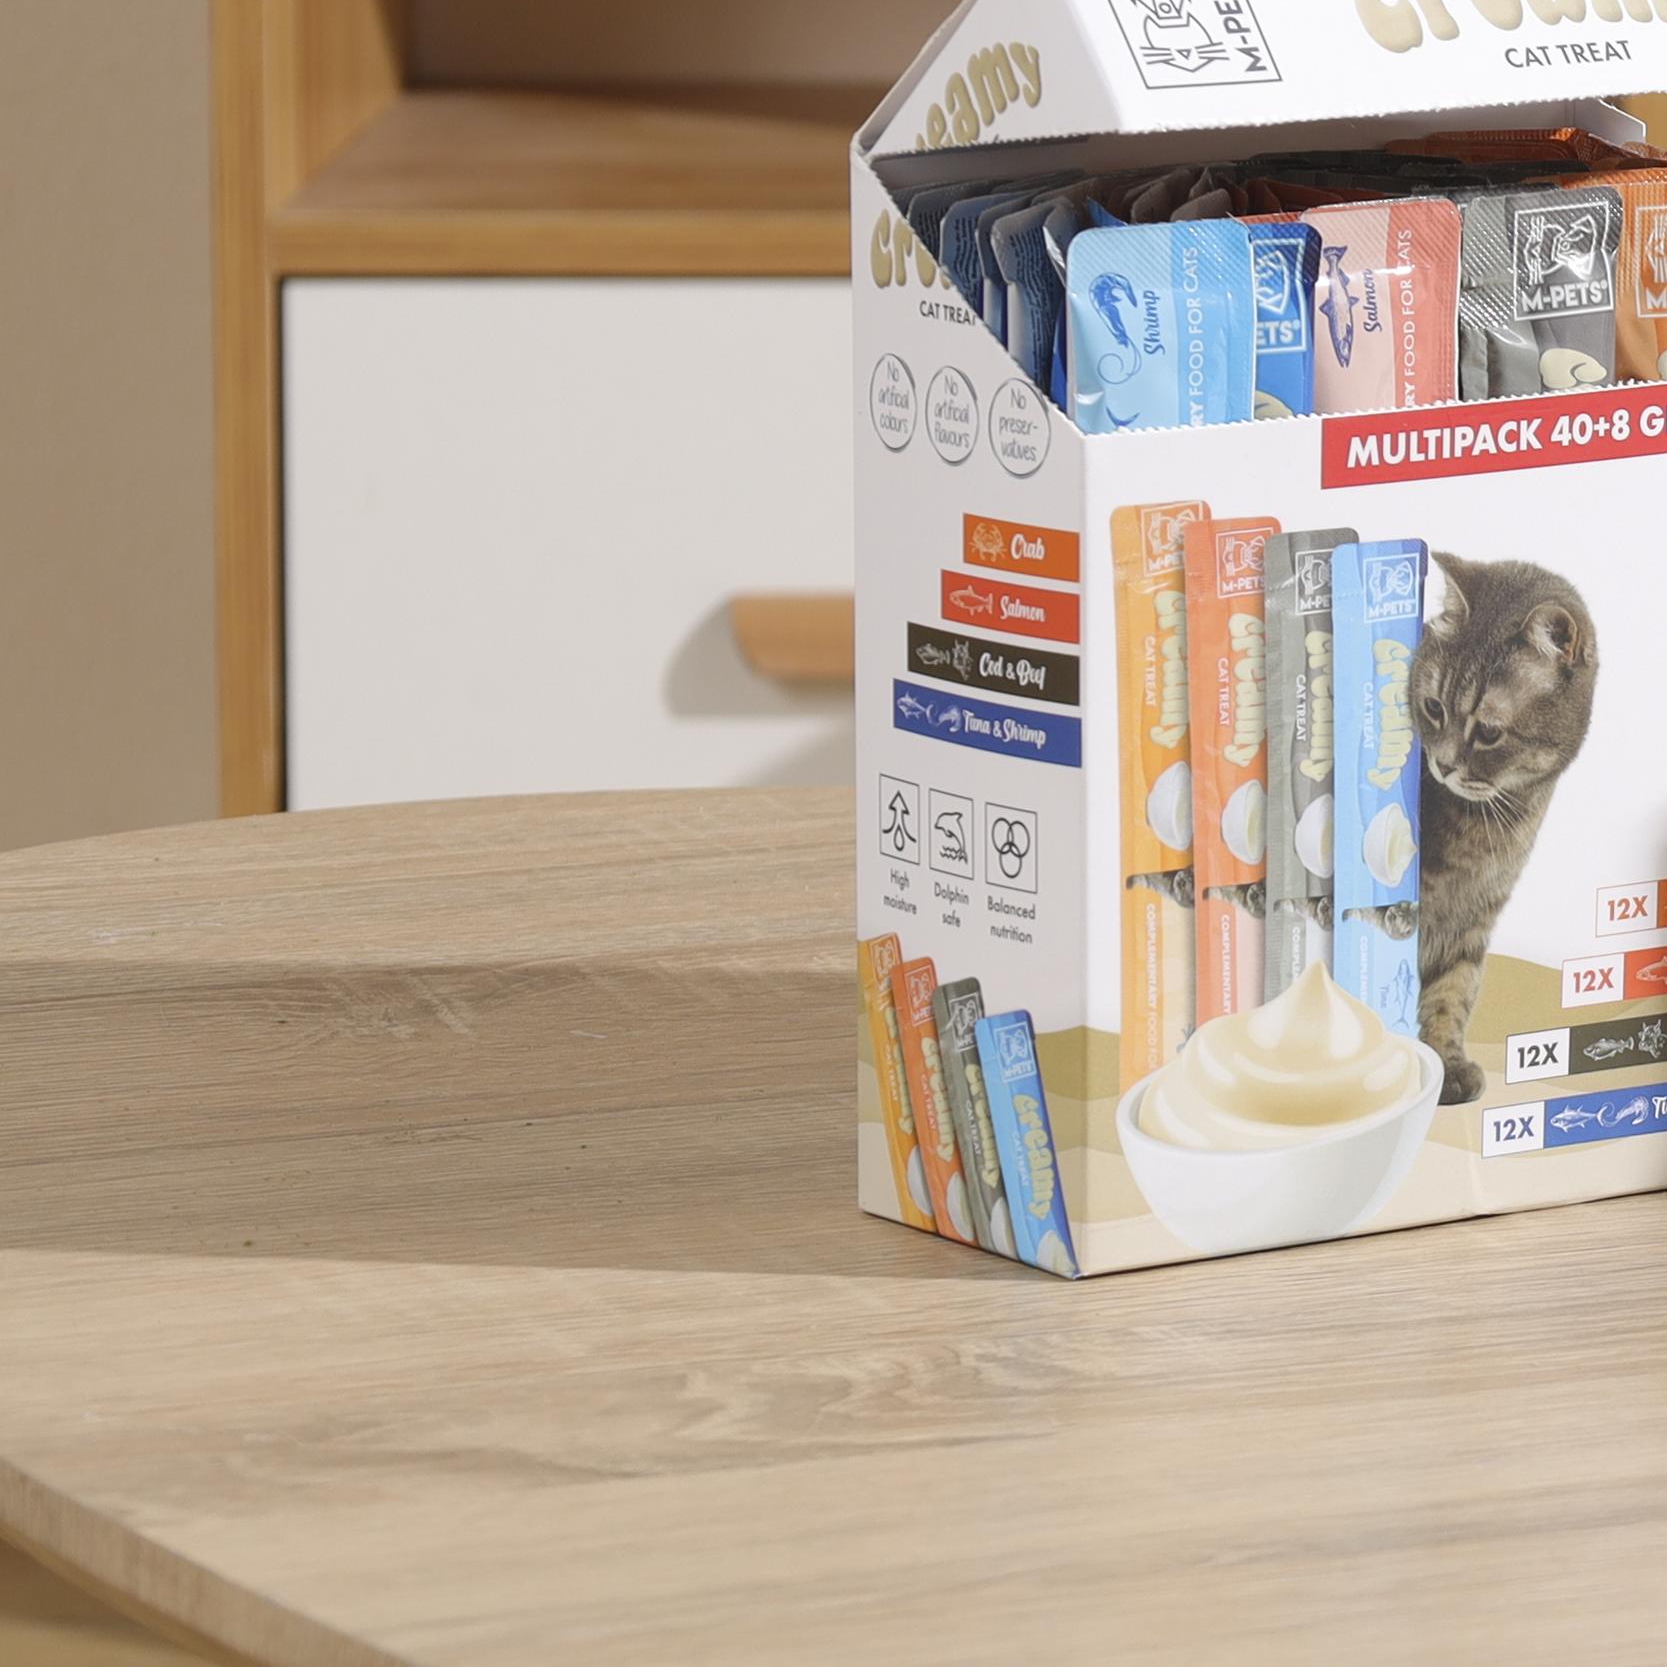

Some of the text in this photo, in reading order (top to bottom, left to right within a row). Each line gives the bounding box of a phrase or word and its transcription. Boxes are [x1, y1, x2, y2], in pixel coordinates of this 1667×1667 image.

[1504, 40, 1634, 69] CAT TREAT
[1183, 246, 1200, 293] CATS
[919, 300, 940, 319] CAT
[1363, 267, 1383, 333] Salmon
[1400, 279, 1414, 315] FOR
[1143, 289, 1166, 356] Shrimp
[1187, 297, 1203, 334] FOR
[1402, 321, 1416, 377] FOOD
[886, 361, 900, 381] No
[1188, 338, 1204, 397] FOOD
[943, 375, 959, 396] No
[1011, 386, 1027, 410] No
[1346, 417, 1544, 468] MULTIPACK
[1551, 408, 1631, 447] 40+8
[1010, 533, 1045, 561] Crab
[1000, 594, 1046, 623] Salmon
[979, 651, 1047, 691] Cod & Beef
[1217, 657, 1231, 726] CAT TREAT
[1296, 674, 1307, 741] CAT TREAT
[1362, 682, 1374, 750] CAT TREAT
[962, 709, 1047, 750] Tuna & Shrimp
[890, 868, 910, 891] High
[934, 882, 970, 906] Dolphin
[883, 894, 918, 916] moisture
[942, 910, 961, 928] safe
[987, 895, 1037, 921] Balanced
[1607, 894, 1649, 922] 12X
[990, 924, 1033, 945] nutrition
[1573, 966, 1615, 994] 12X
[1517, 1042, 1559, 1070] 12X
[1493, 1114, 1535, 1142] 12X
[1013, 1093, 1055, 1221] creamy
